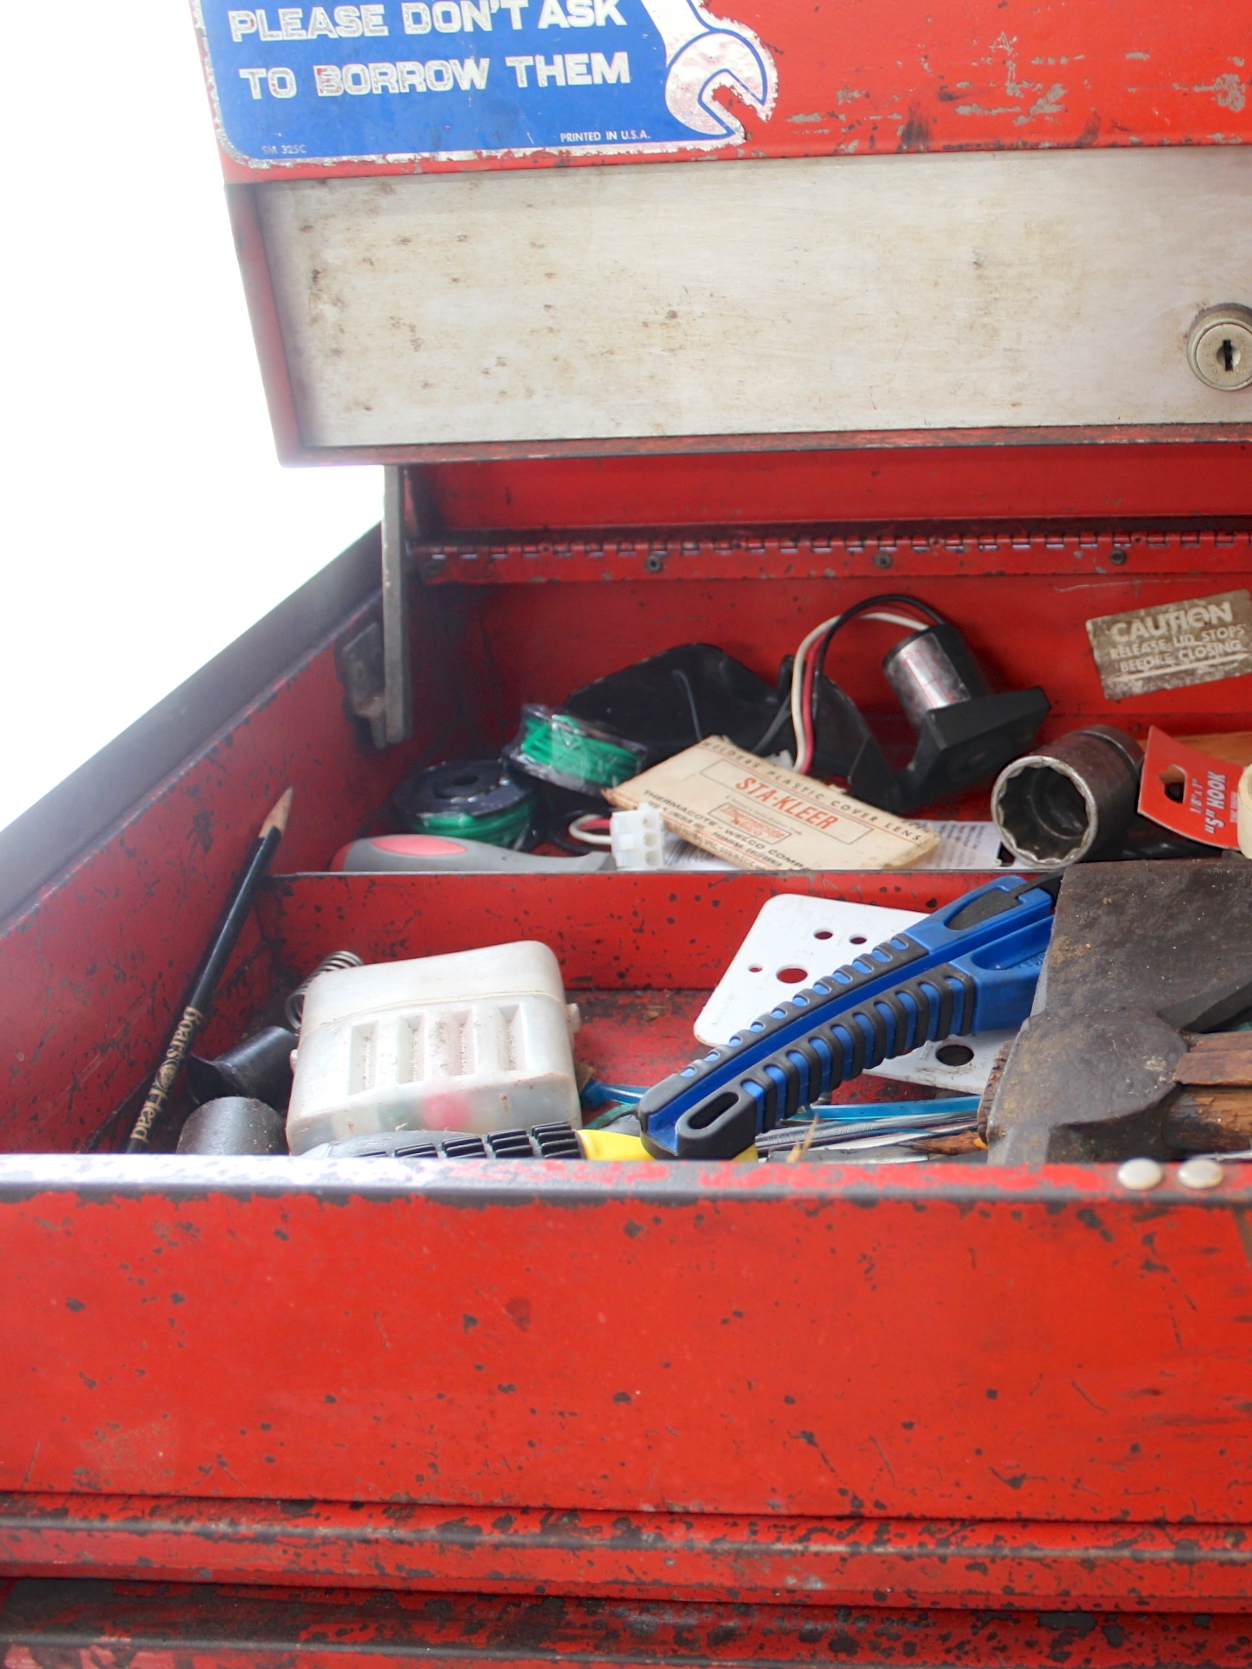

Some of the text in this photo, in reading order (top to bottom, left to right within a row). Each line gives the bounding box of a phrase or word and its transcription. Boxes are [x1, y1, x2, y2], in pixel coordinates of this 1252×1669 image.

[228, 0, 628, 42] PLEASE DON'T ASK
[238, 51, 631, 99] TO BORROW THEM
[560, 129, 651, 142] PRINTED IN U.S.A.
[1110, 601, 1234, 642] CAUTION
[1110, 625, 1245, 660] RELEASE LID STOPS
[1178, 639, 1242, 664] CLOSING
[735, 776, 842, 830] STA-KLEER
[767, 770, 825, 800] PLASTIC
[831, 799, 878, 824] COVER
[884, 821, 923, 841] LENS
[1205, 770, 1227, 835] "S" HOOK
[768, 848, 811, 870] COMP
[130, 1087, 169, 1144] Head
